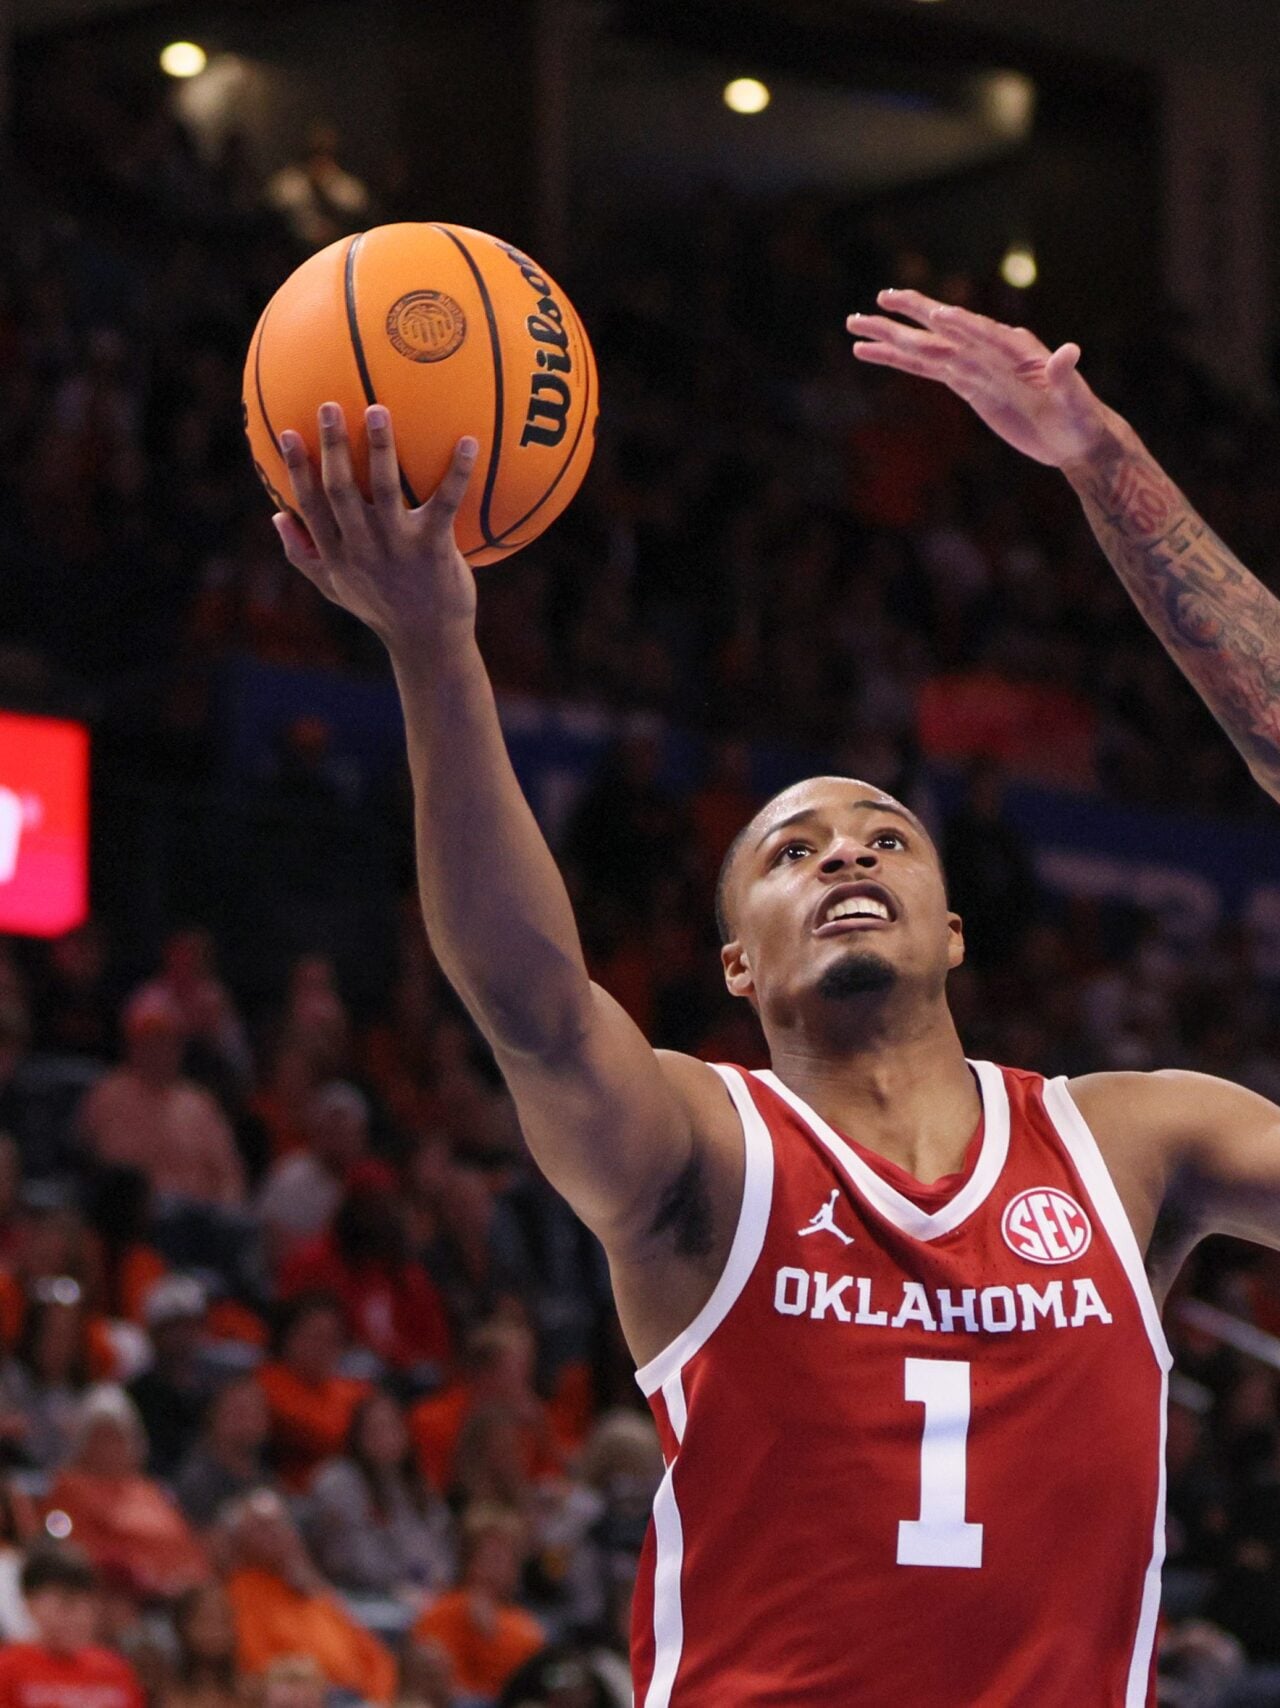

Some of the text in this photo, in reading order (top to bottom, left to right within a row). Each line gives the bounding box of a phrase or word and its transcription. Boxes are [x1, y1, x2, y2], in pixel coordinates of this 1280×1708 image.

[1008, 1193, 1085, 1259] SEC
[774, 1266, 1112, 1333] OKLAHOMA
[896, 1357, 983, 1568] 1
